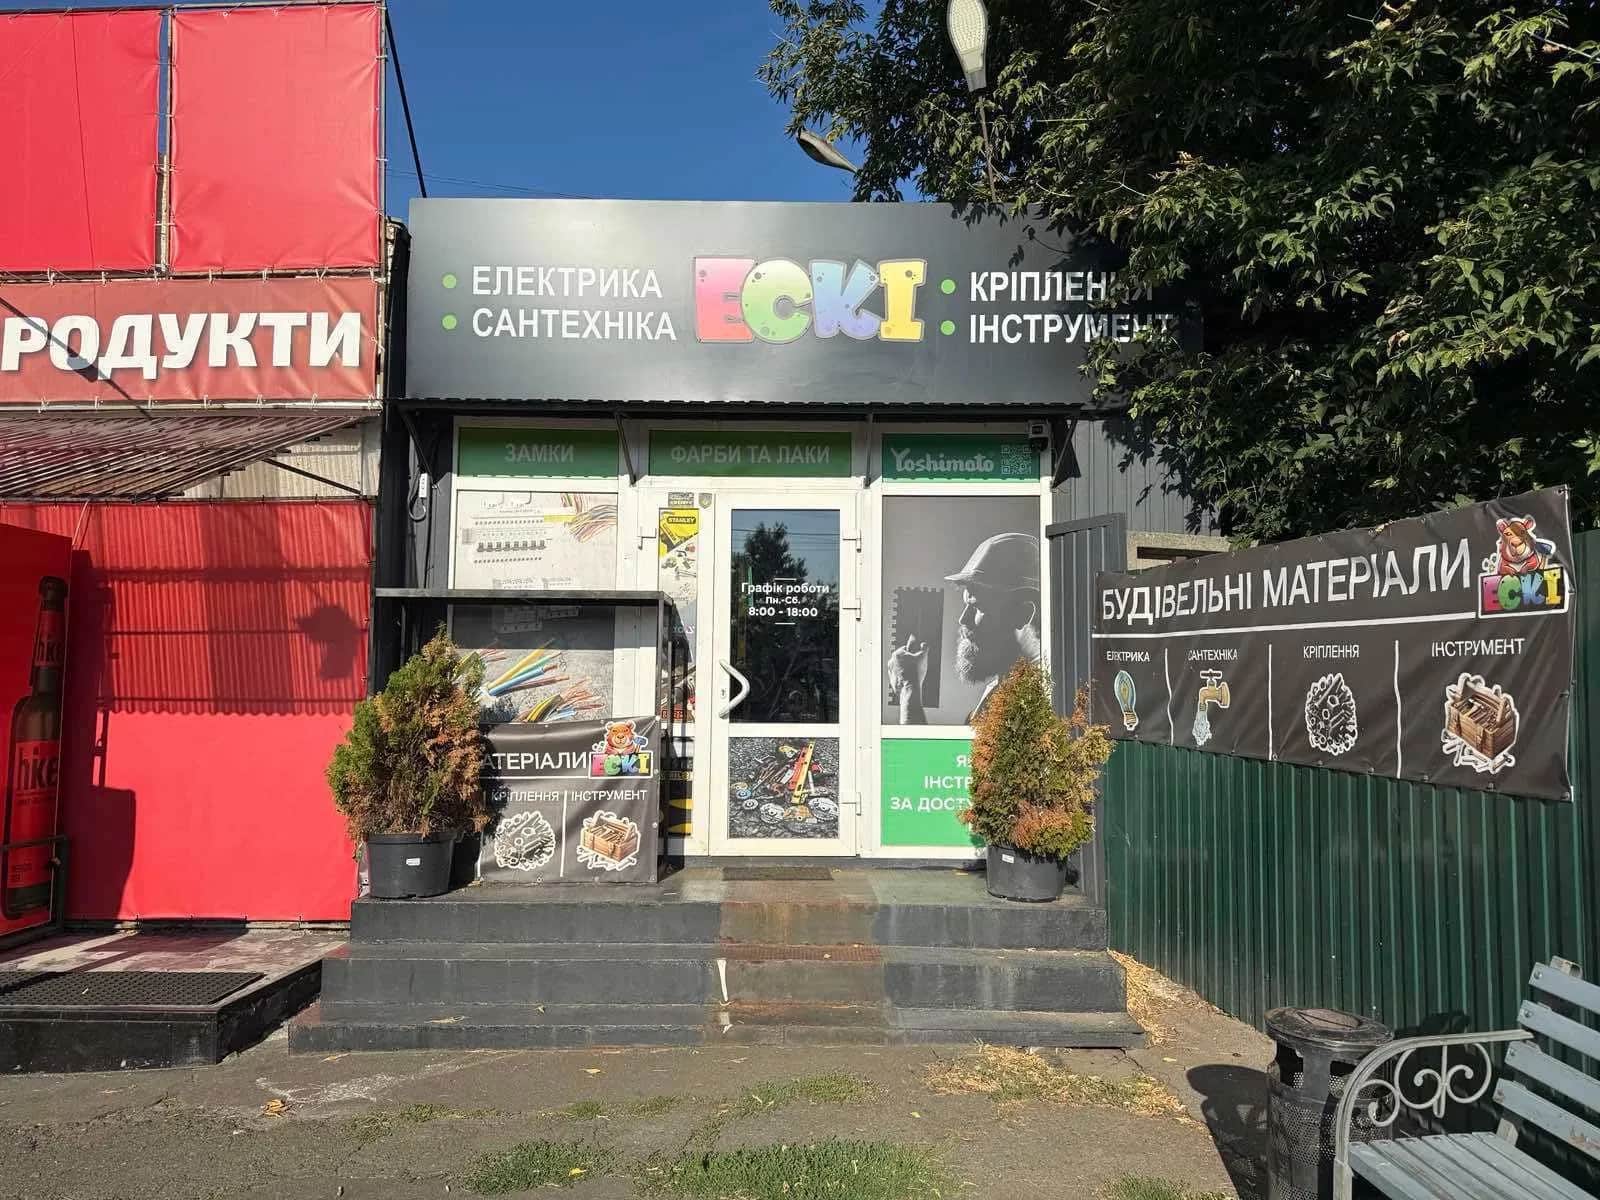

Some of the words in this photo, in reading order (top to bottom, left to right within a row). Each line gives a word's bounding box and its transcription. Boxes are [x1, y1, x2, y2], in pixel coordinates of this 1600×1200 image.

[471, 265, 664, 299] ЕЛЕКТРИКА
[471, 307, 678, 341] САНТЕХНІКА
[969, 313, 1174, 343] ІНСТРУМЕНТ
[1, 312, 361, 380] РОДУКТИ
[504, 443, 575, 464] ЗАМКИ
[670, 445, 742, 465] ФАРБИ
[749, 446, 772, 464] ТА
[775, 446, 831, 466] ЛАКИ
[740, 582, 783, 595] Графік
[785, 582, 830, 595] роботи
[1101, 571, 1253, 626] БУДІВЕЛЬНІ
[1262, 537, 1471, 608] МАТЕРІАЛИ
[748, 607, 776, 617] 8:00
[787, 607, 819, 618] 18:00
[1302, 641, 1361, 659] КРІПЛЕННЯ
[1431, 637, 1525, 657] ІНСТРУМЕНТ
[481, 751, 588, 770] АТЕРІАЛИ
[923, 775, 974, 789] ІНСТР
[491, 790, 560, 802] КРІПЛЕННЯ
[570, 789, 649, 802] ІНСТРУМЕНТ
[889, 796, 913, 810] ЗА
